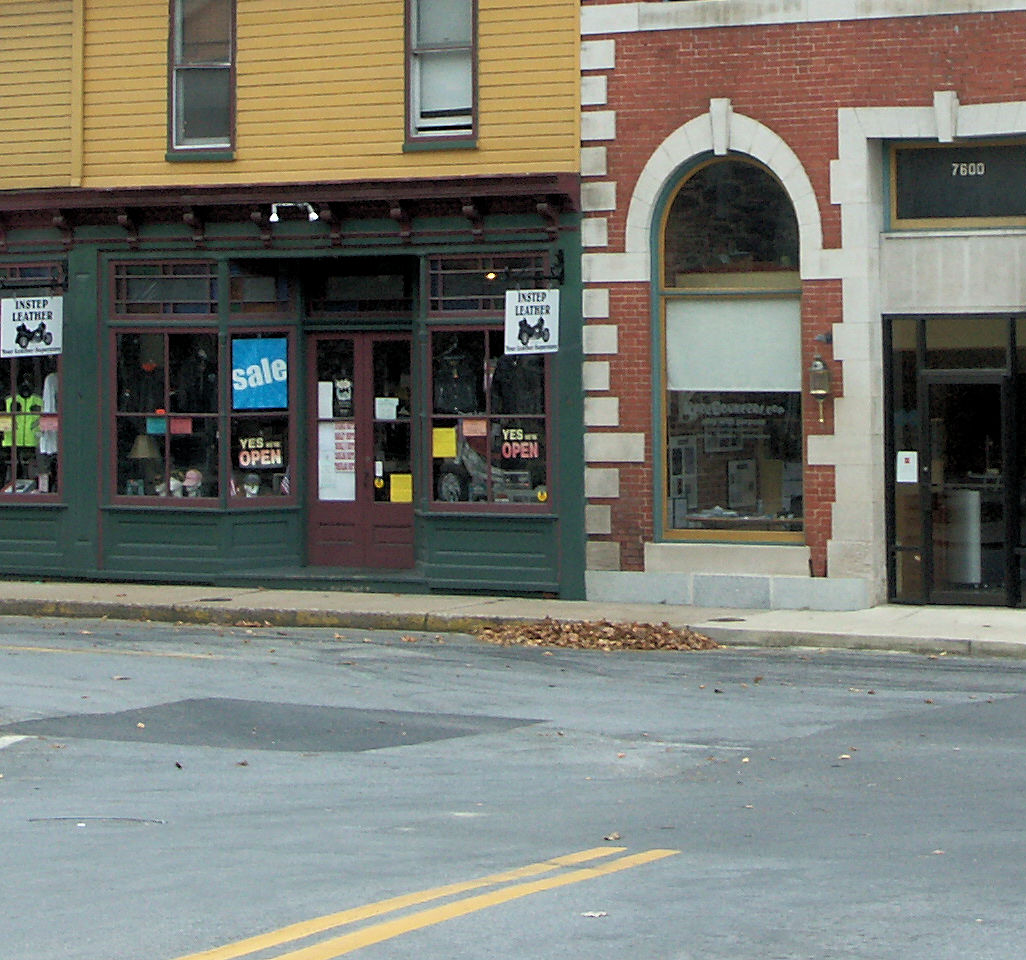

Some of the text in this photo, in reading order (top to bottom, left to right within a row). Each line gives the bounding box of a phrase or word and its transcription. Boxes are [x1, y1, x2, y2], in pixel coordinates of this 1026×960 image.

[952, 163, 985, 176] 7600
[518, 292, 547, 303] INSTEP
[15, 299, 49, 310] INSTEP
[515, 305, 551, 316] LEATHER
[12, 310, 53, 322] LEATHER
[232, 357, 288, 392] sale
[502, 429, 524, 440] YES
[239, 437, 264, 449] YES
[502, 441, 539, 459] OPEN
[239, 449, 281, 467] OPEN
